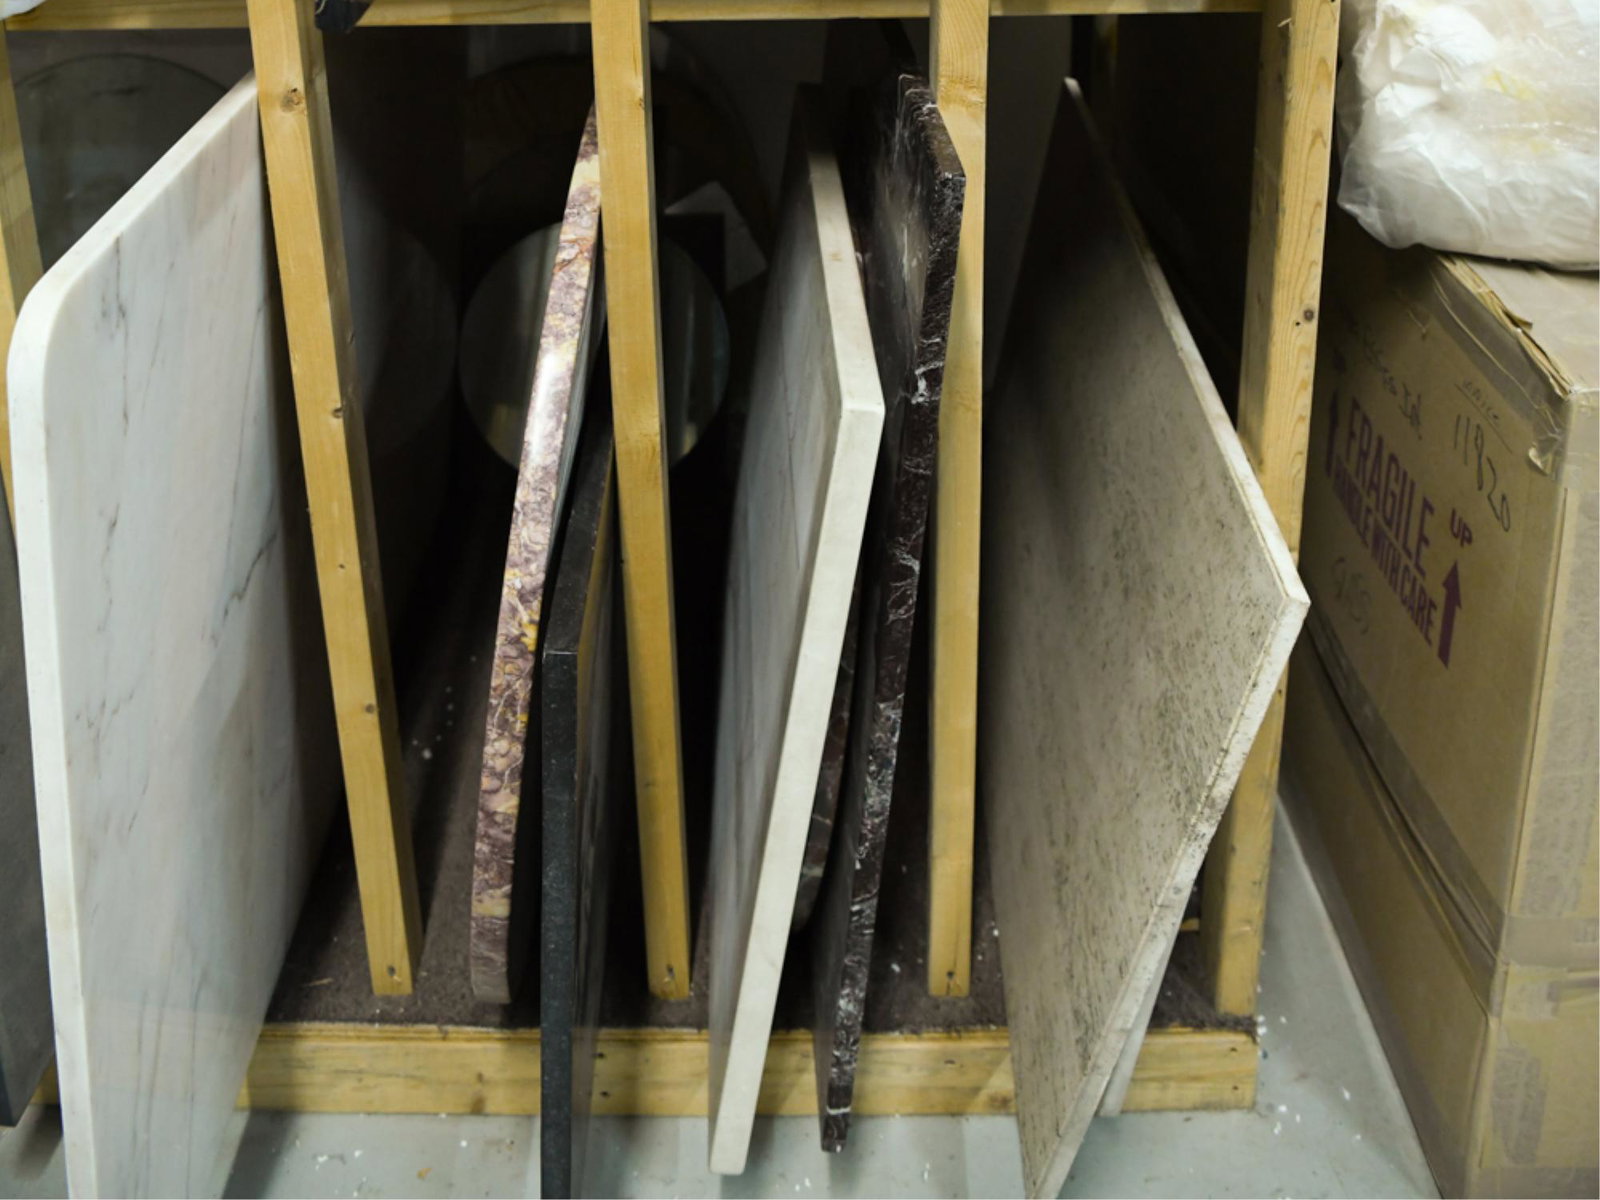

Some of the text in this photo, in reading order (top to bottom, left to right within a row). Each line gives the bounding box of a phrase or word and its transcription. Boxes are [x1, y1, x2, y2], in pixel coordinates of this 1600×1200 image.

[1346, 396, 1435, 578] FRAGILE
[1450, 508, 1473, 548] UP
[1399, 558, 1438, 648] CARE
